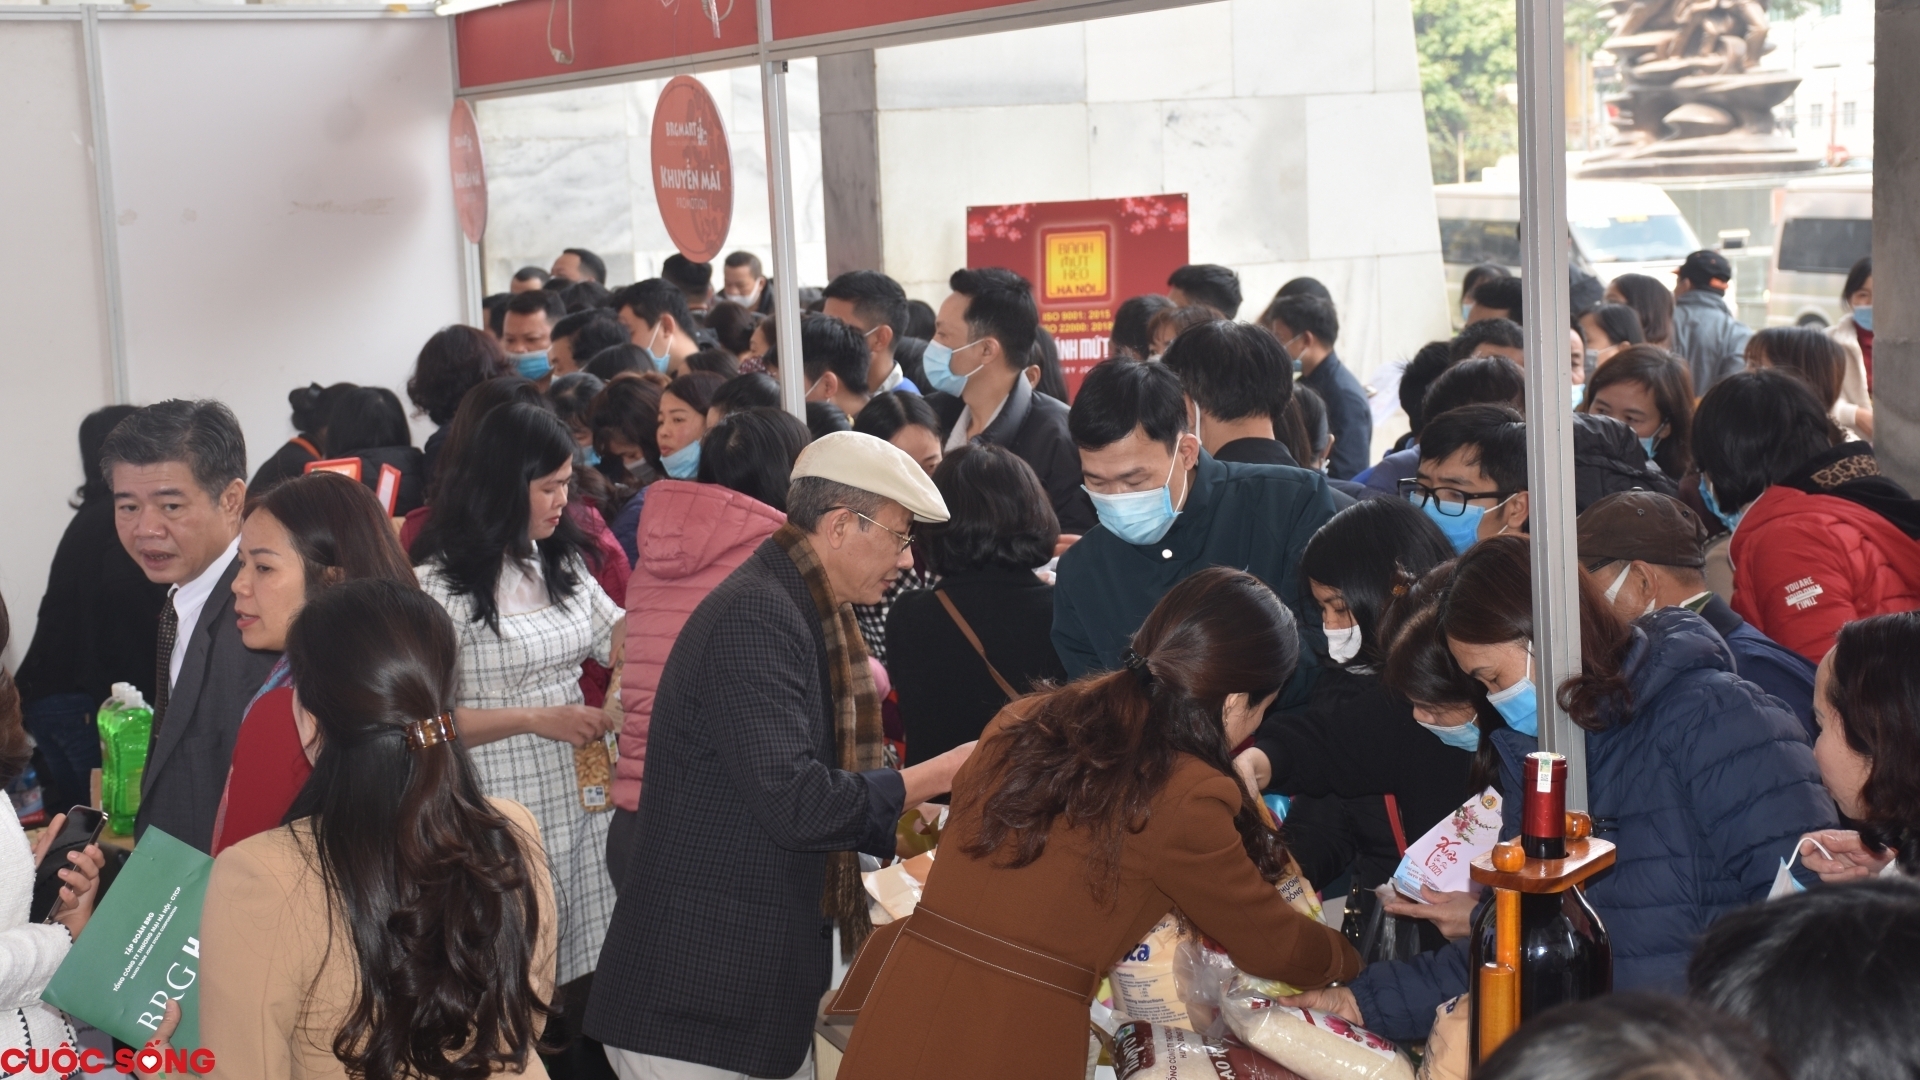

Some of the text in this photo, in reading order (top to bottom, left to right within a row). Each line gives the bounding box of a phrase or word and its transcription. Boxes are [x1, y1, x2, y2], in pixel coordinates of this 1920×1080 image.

[666, 121, 697, 137] BRGMART
[660, 159, 721, 191] KHUYẾN MÃI
[1042, 311, 1060, 322] ISO
[1088, 309, 1111, 320] 2015
[1080, 334, 1110, 360] MỨT
[1784, 576, 1815, 593] YOU ARE
[1428, 862, 1443, 877] 2021
[123, 960, 136, 977] CÔNG
[133, 953, 140, 961] TY
[150, 921, 160, 933] MẠI
[157, 913, 165, 922] HÀ
[162, 902, 171, 914] NỘI
[124, 912, 155, 956] TẬP ĐOÀN BRG
